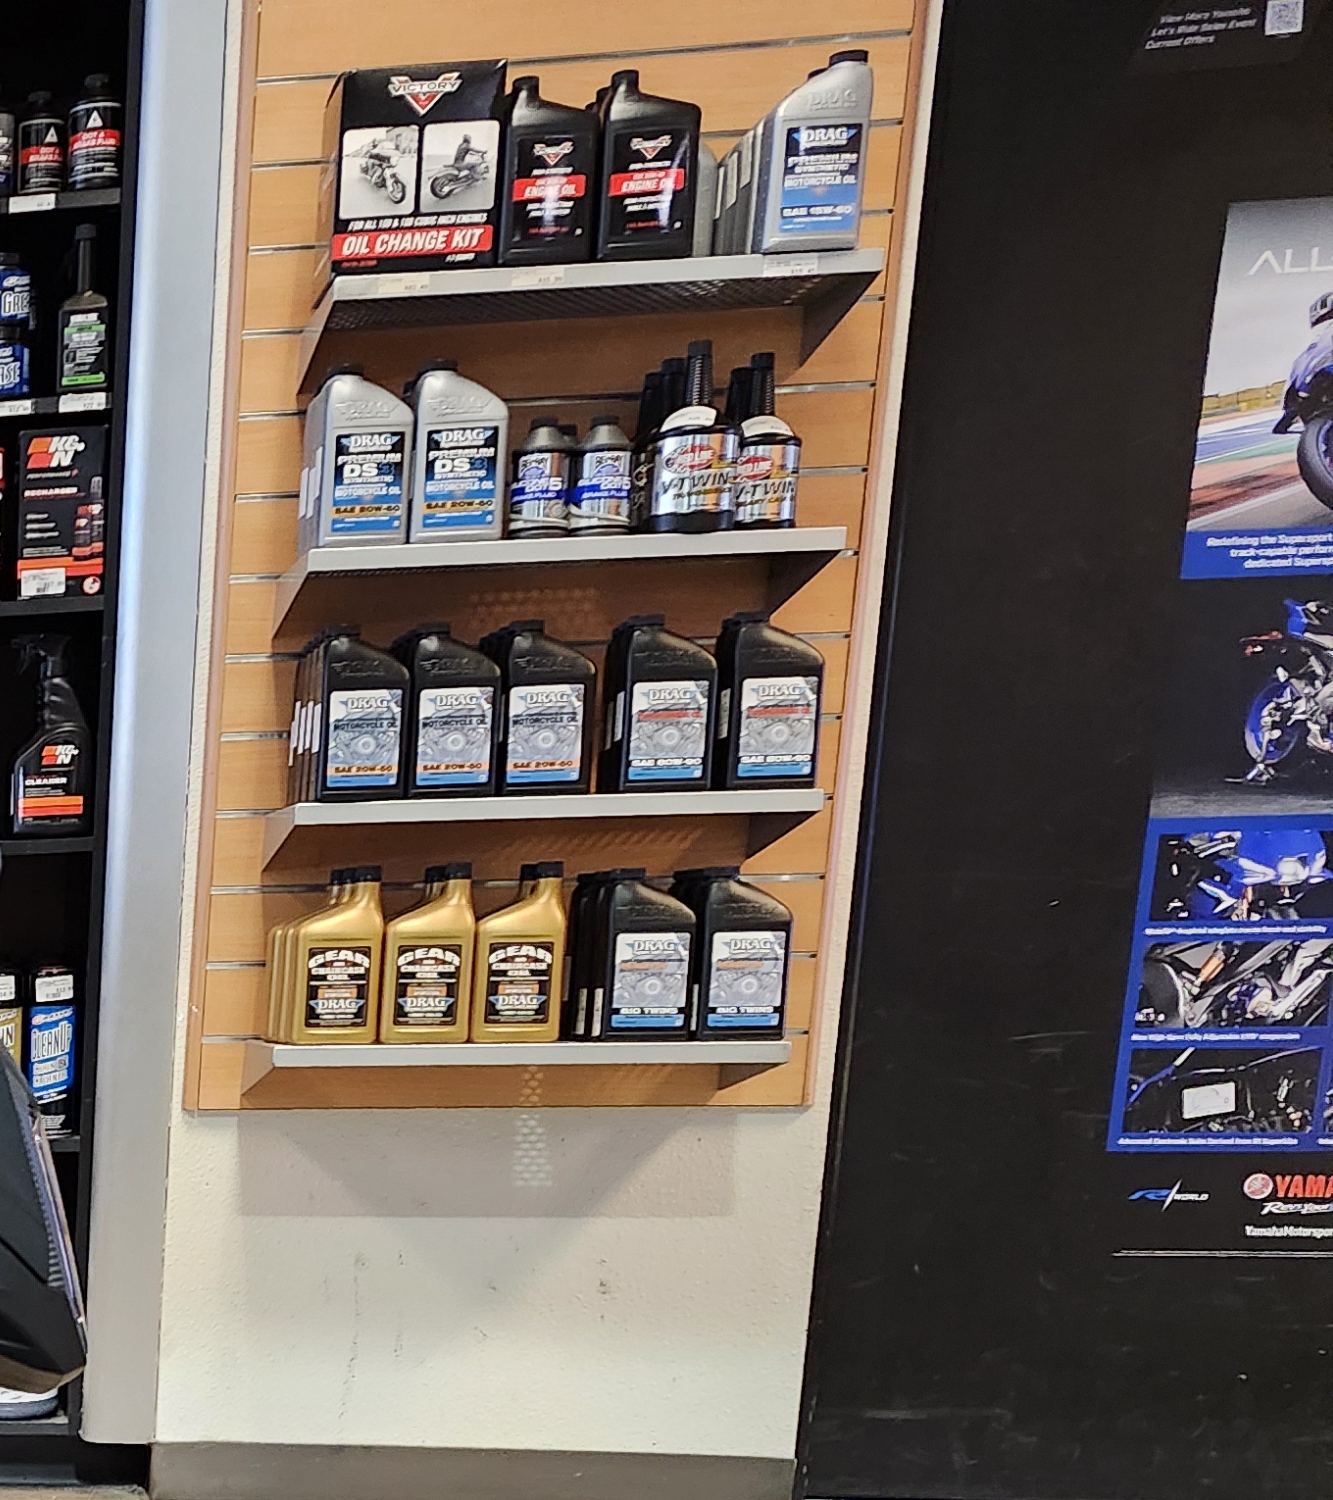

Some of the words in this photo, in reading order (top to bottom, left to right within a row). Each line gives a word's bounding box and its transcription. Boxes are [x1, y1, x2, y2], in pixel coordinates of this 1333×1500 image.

[391, 80, 460, 95] VICTORY
[804, 128, 848, 142] DRAG
[564, 184, 576, 195] OIL
[621, 178, 658, 191] ENGINE
[343, 236, 369, 255] OIL
[374, 232, 447, 252] CHANGE
[451, 229, 484, 249] KIT
[350, 434, 392, 448] DRAG
[442, 429, 483, 442] DRAG
[49, 435, 85, 467] K&N
[429, 448, 495, 460] PREMIUM
[338, 453, 401, 466] PREMIUM
[426, 482, 480, 493] MOTORCYCLE
[482, 481, 495, 490] OIL
[549, 477, 562, 490] 5
[662, 470, 730, 495] V-TWIN
[24, 486, 78, 498] RECHARGER
[335, 486, 387, 498] MOTORCYCLE
[389, 486, 402, 495] OIL
[335, 507, 355, 515] SAE
[426, 501, 447, 510] SAE
[1207, 537, 1259, 547] Redefining
[1260, 536, 1277, 544] the
[649, 688, 691, 700] DRAG
[759, 685, 800, 697] DRAG
[348, 697, 387, 709] DRAG
[437, 695, 478, 706] DRAG
[526, 692, 568, 704] DRAG
[334, 721, 385, 729] MOTORCYCLE
[422, 719, 475, 728] MOTORCYCLE
[512, 717, 566, 726] MOTORCYCLE
[633, 759, 655, 767] SAE
[741, 755, 764, 764] SAE
[25, 777, 68, 786] CLEANER
[634, 940, 674, 952] DRAG
[730, 939, 771, 950] DRAG
[308, 950, 370, 968] GEAR
[398, 948, 461, 966] GEAR
[489, 945, 552, 964] GEAR
[319, 999, 357, 1010] DRAG
[407, 998, 446, 1008] DRAG
[499, 995, 538, 1006] DRAG
